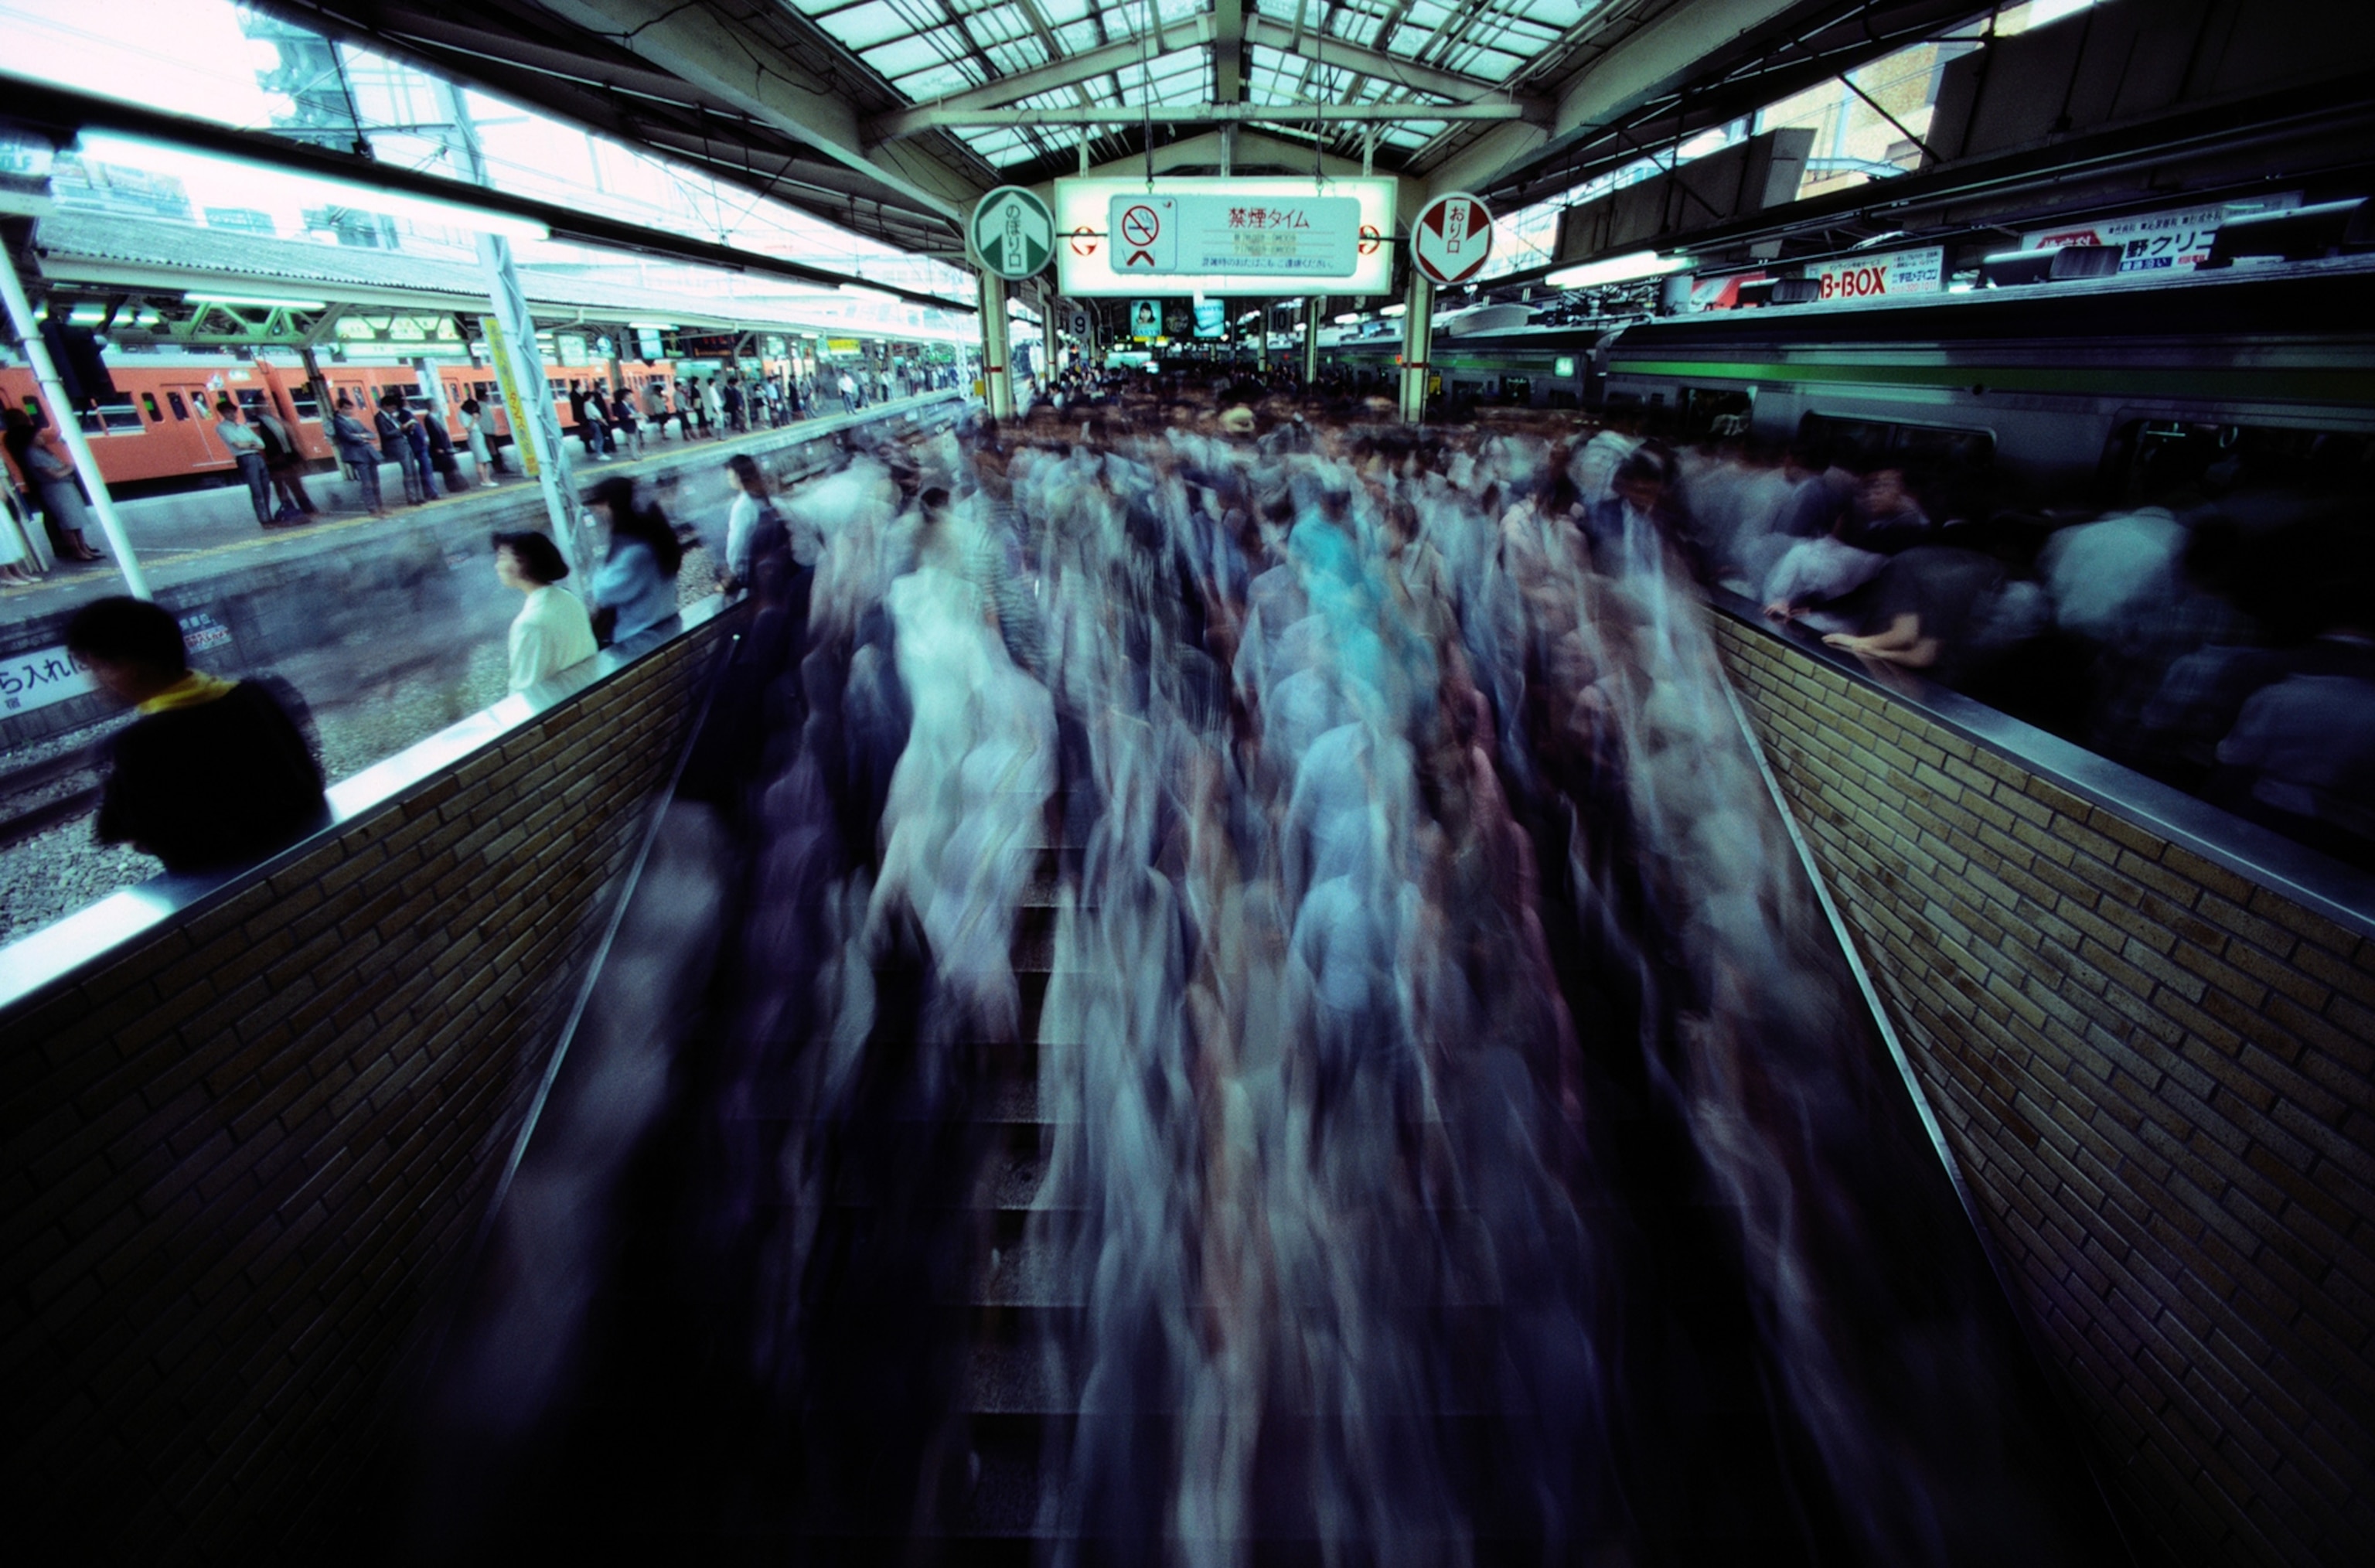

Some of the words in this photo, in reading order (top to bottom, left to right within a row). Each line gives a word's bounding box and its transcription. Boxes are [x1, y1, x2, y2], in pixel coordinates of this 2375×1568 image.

[1228, 207, 1310, 229] 禁煙タイム
[1447, 206, 1466, 254] おり口
[1006, 204, 1021, 268] のぼり口
[1820, 265, 1888, 299] B-BOX
[1075, 315, 1085, 334] 9
[1273, 311, 1287, 329] 10
